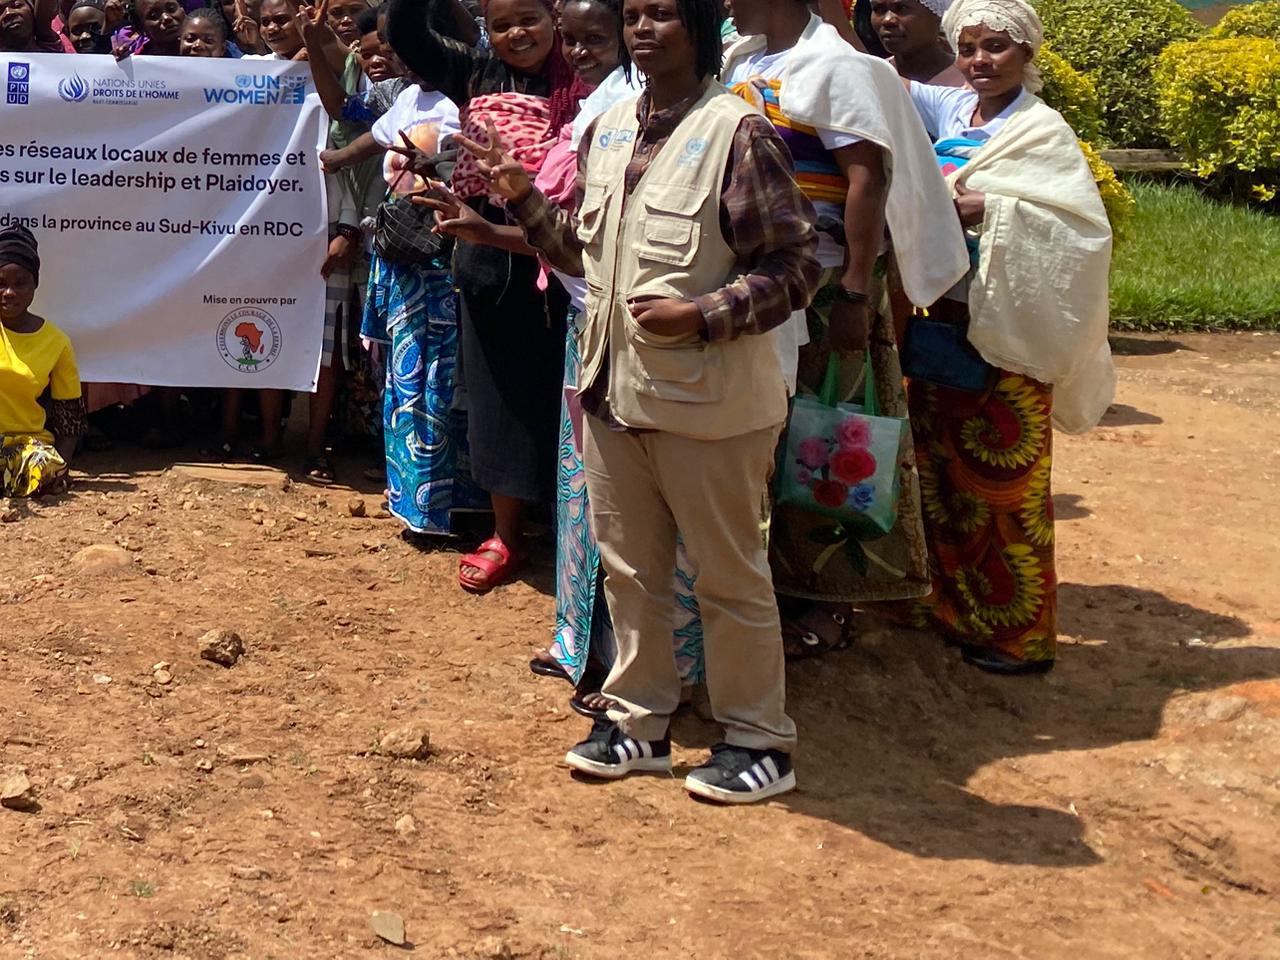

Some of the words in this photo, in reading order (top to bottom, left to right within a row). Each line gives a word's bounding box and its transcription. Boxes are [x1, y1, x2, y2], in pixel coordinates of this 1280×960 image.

[93, 78, 135, 88] NATIONS
[138, 80, 166, 89] UNIES
[253, 74, 280, 89] UN
[93, 89, 123, 98] DROITS
[126, 90, 136, 98] DE
[139, 90, 179, 100] L'HOMME
[204, 88, 280, 104] WOMEN
[20, 141, 97, 160] réseaux
[102, 144, 168, 163] locaux
[173, 147, 197, 164] de
[202, 148, 280, 166] femmes
[286, 150, 306, 166] et
[14, 171, 45, 184] sur
[49, 168, 67, 185] le
[72, 169, 176, 192] leadership
[181, 175, 201, 190] et
[206, 174, 304, 194] Plaidoyer.
[0, 212, 38, 228] dans
[42, 214, 56, 228] la
[60, 216, 132, 232] province
[136, 221, 155, 232] au
[159, 218, 235, 235] Sud-Kivu
[240, 224, 259, 235] en
[264, 222, 303, 236] RDC
[203, 295, 227, 304] Mise
[280, 298, 296, 306] par
